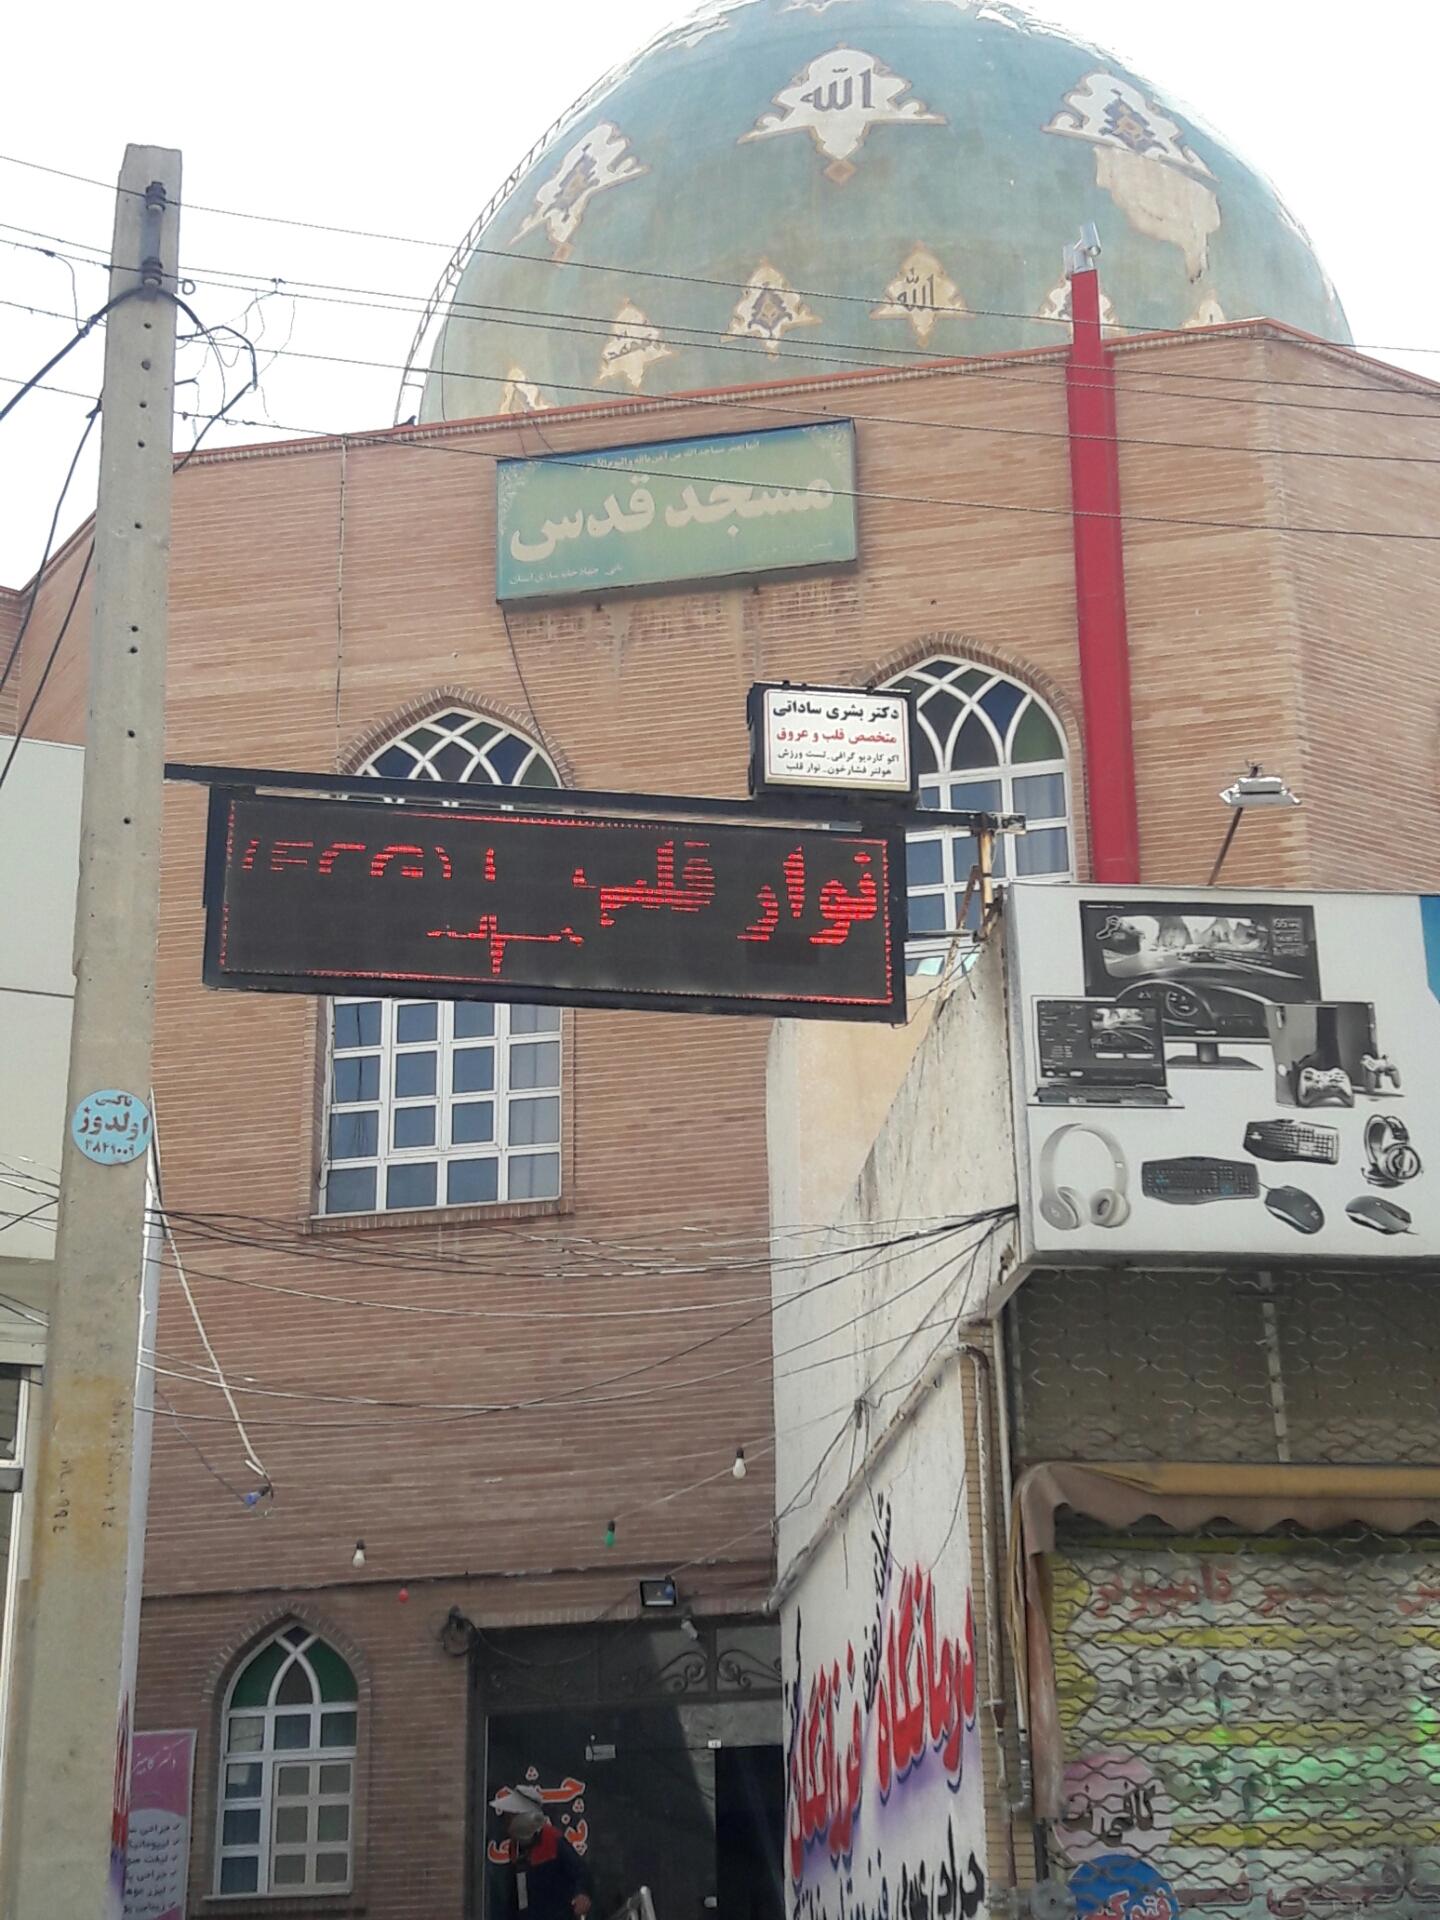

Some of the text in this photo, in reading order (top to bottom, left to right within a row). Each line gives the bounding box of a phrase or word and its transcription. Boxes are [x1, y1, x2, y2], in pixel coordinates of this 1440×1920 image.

[799, 67, 876, 112] الله
[510, 475, 834, 562] مسجد قدس
[773, 700, 900, 722] دکتر بشری ساداتی
[776, 727, 897, 745] متخصص قلب و عروق
[786, 762, 804, 771] قلب
[877, 1561, 976, 1800] درمانگاه
